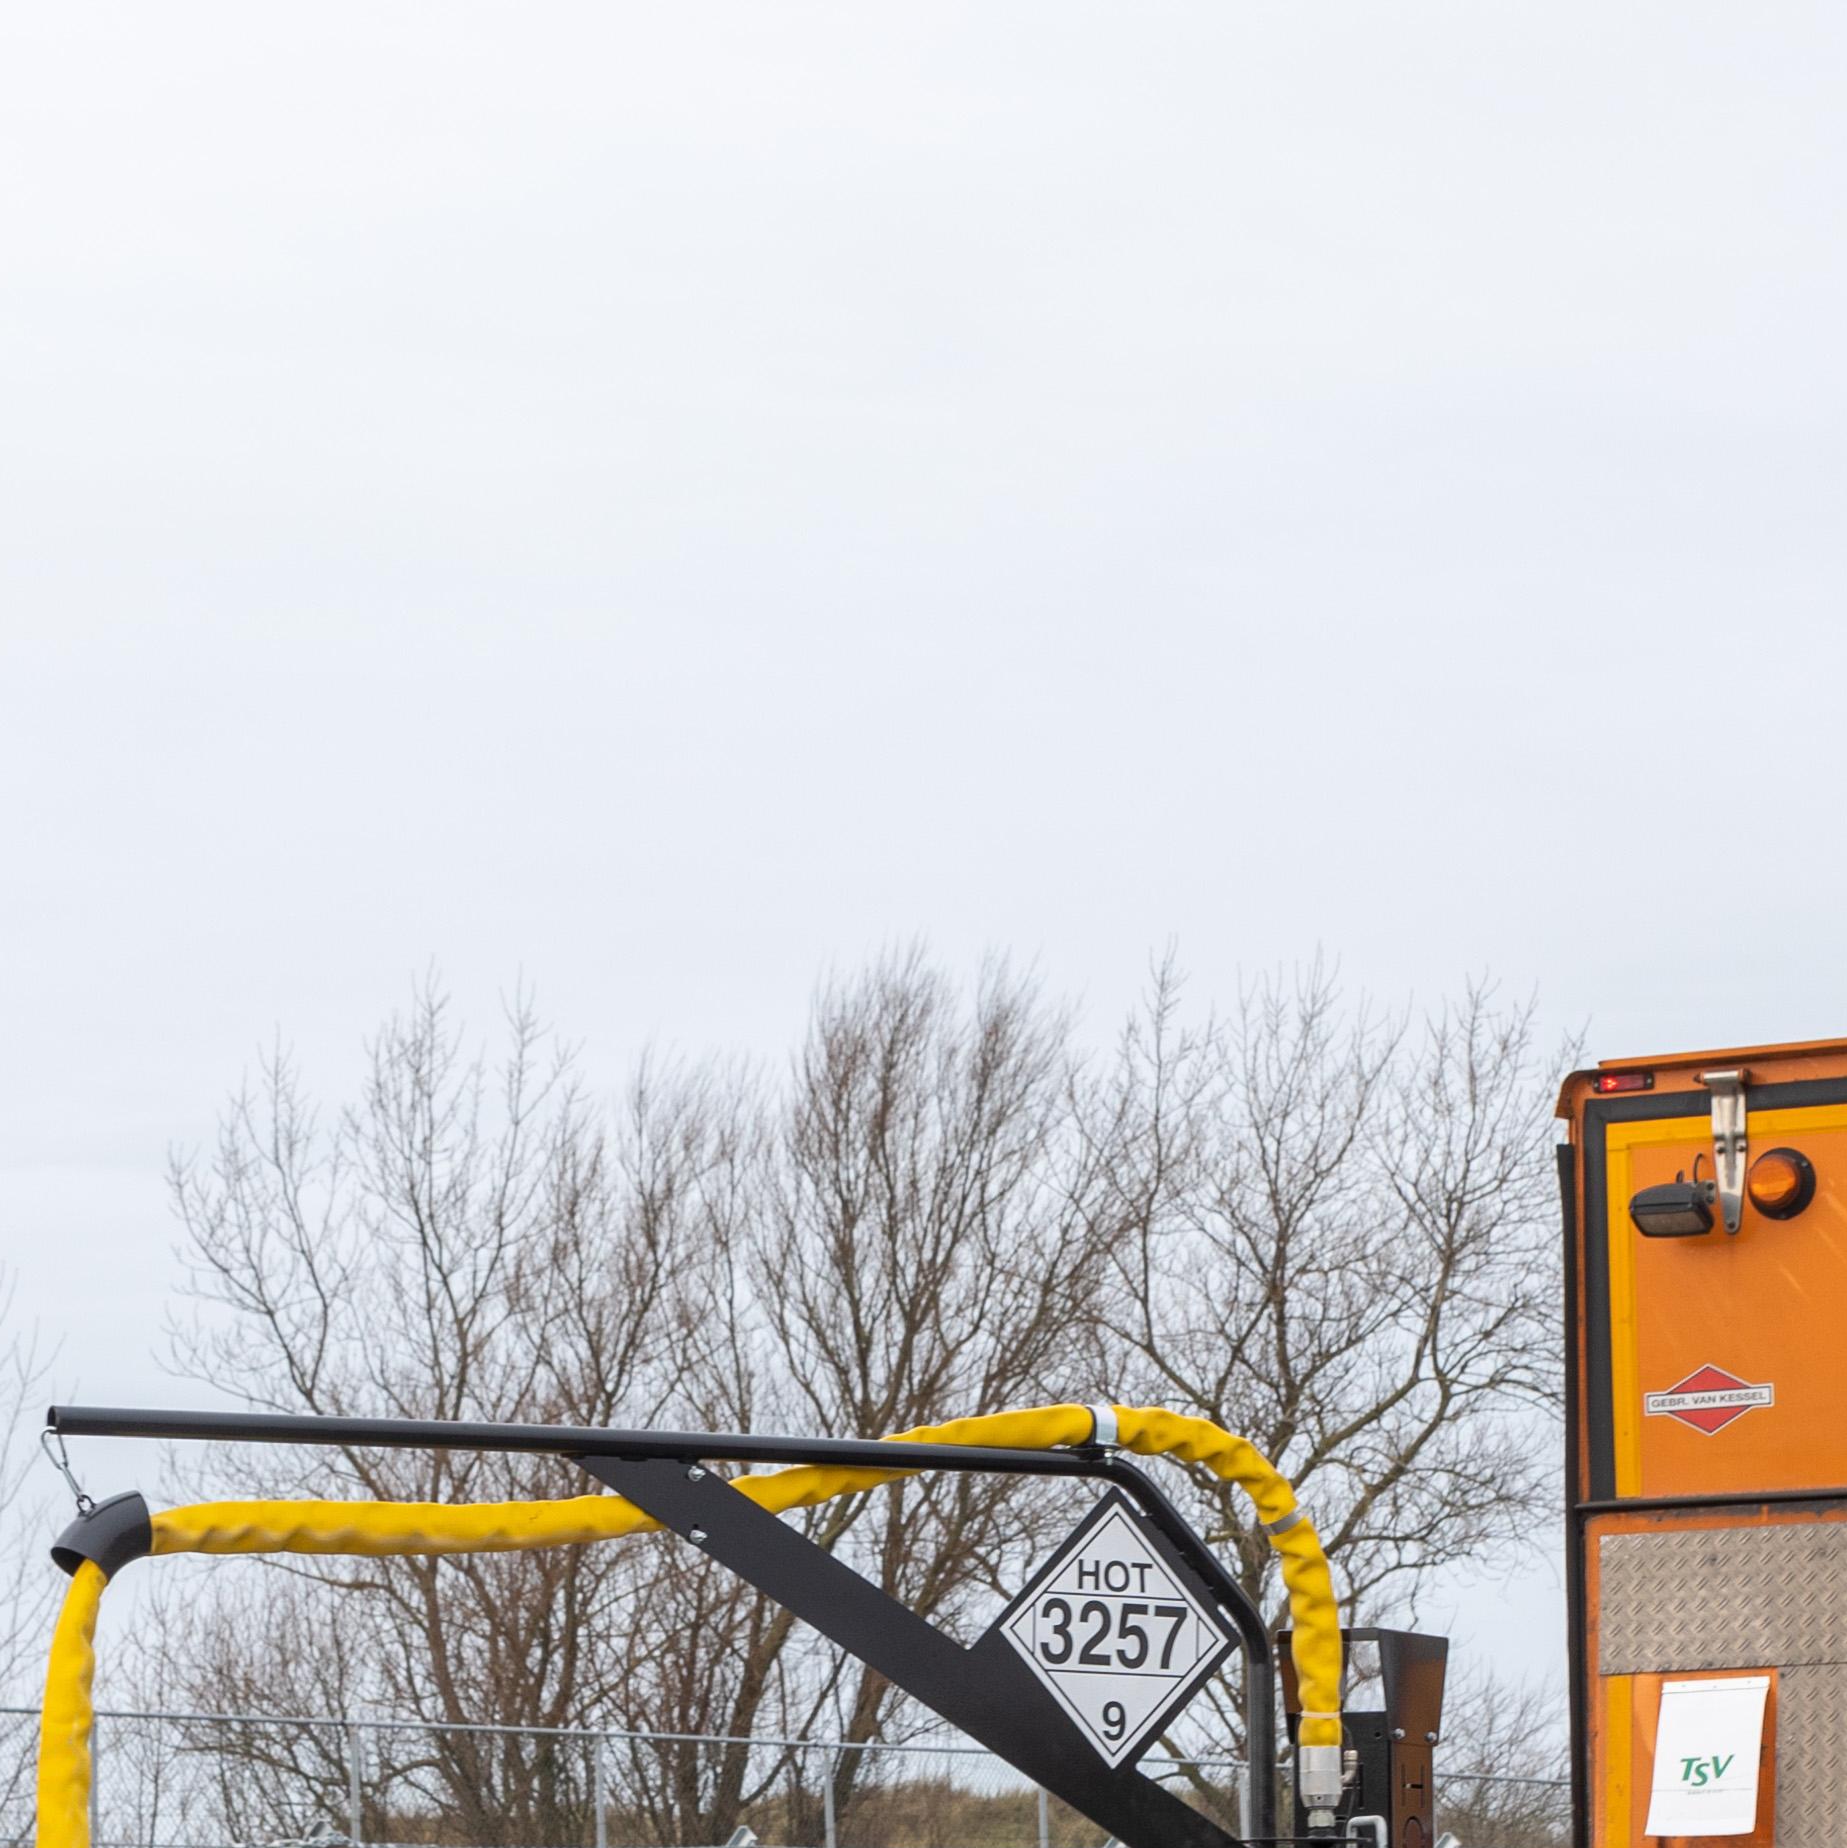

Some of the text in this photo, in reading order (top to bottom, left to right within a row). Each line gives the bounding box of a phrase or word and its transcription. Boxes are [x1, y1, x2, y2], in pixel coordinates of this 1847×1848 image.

[1651, 1391, 1767, 1409] GEBR. VAN KESSEL
[1077, 1560, 1153, 1594] HOT
[1039, 1598, 1189, 1670] 3257
[1101, 1700, 1126, 1742] 9
